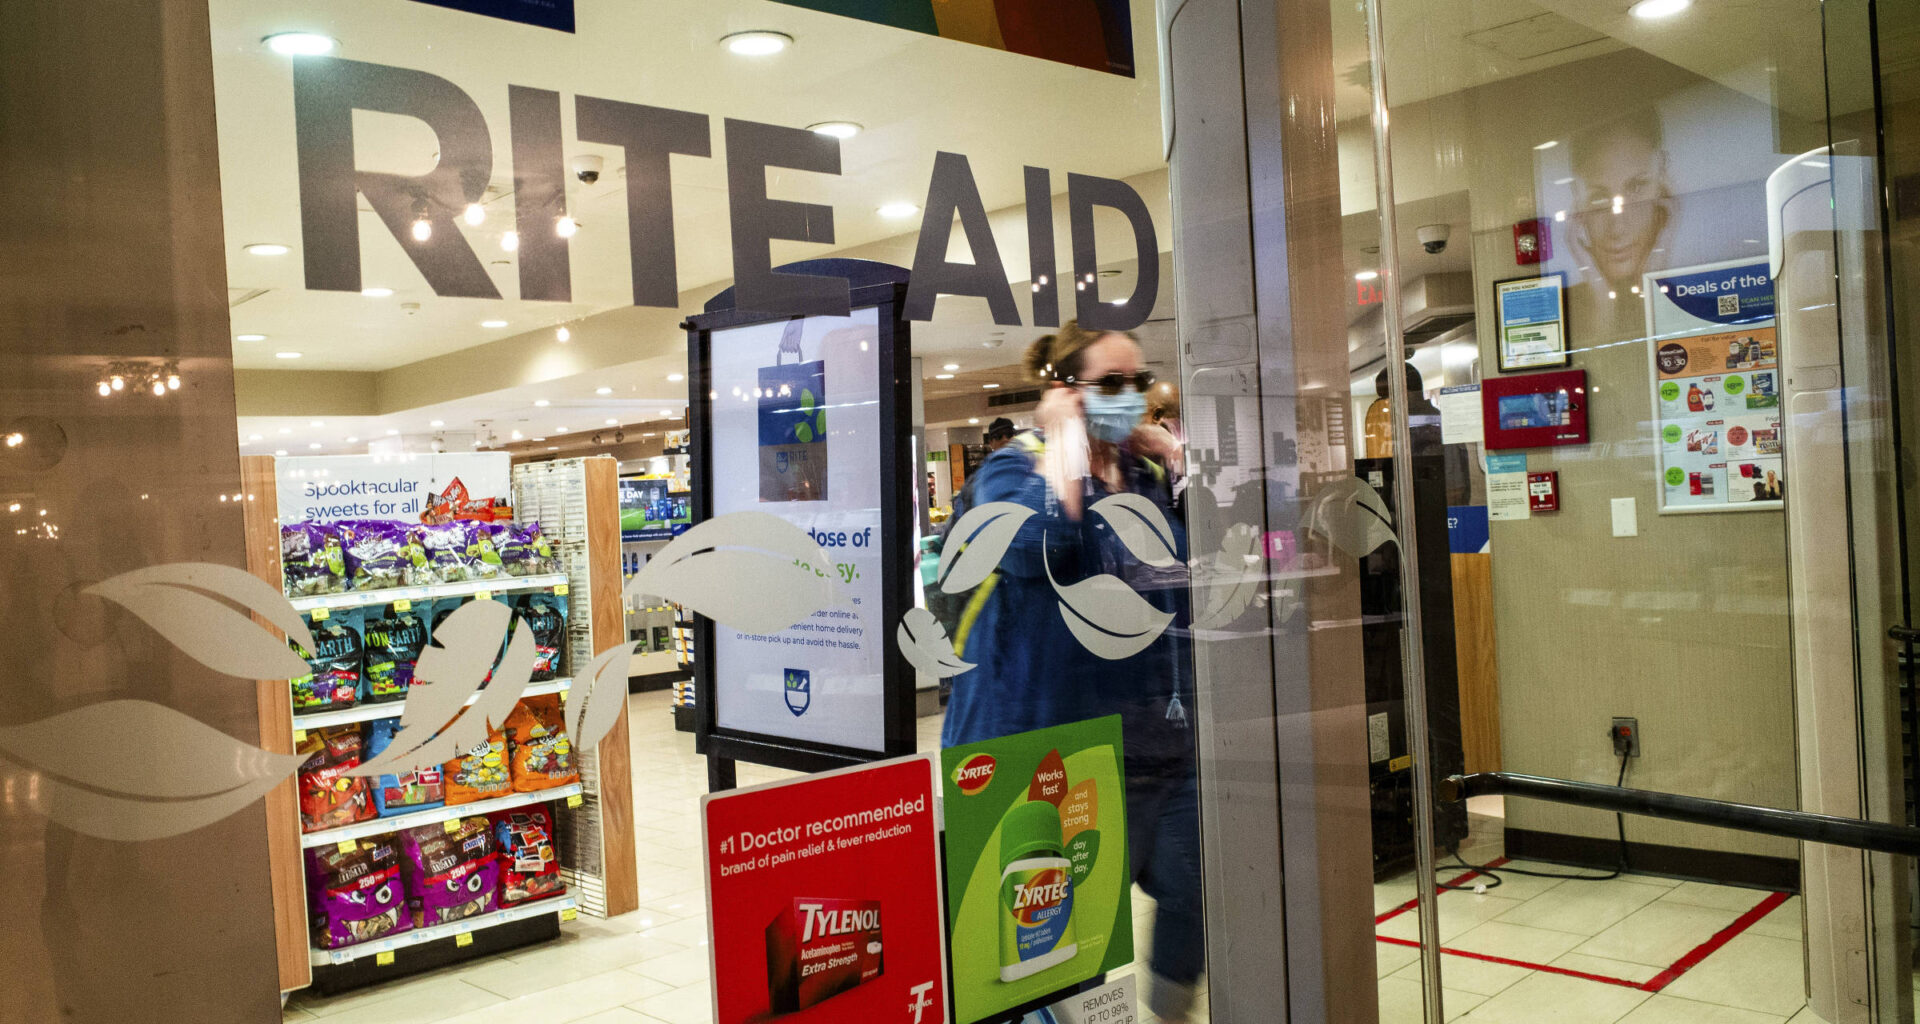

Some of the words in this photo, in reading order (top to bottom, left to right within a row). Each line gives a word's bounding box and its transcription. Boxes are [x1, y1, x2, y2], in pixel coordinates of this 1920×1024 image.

[293, 54, 851, 317] RITE
[901, 151, 1160, 331] AID
[1676, 280, 1718, 297] Deals
[1721, 276, 1738, 290] of
[1740, 274, 1767, 288] the
[304, 478, 419, 501] Spooktacular
[626, 490, 644, 499] DAY
[306, 503, 369, 519] sweets
[374, 500, 396, 515] for
[401, 498, 419, 513] all
[852, 527, 871, 547] of
[829, 609, 853, 620] online
[815, 624, 835, 634] home
[836, 625, 863, 637] delivery
[744, 632, 767, 642] in-store
[768, 634, 781, 644] pick
[782, 636, 791, 645] up
[792, 636, 805, 646] and
[806, 637, 824, 648] avoid
[825, 639, 837, 648] the
[838, 640, 861, 650] hassle.
[957, 764, 993, 782] ZYRTEC
[1037, 769, 1064, 784] Works
[1074, 790, 1088, 800] and
[1067, 802, 1089, 815] stays
[720, 834, 735, 854] #1
[740, 825, 802, 852] Doctor
[806, 793, 925, 837] recommended
[1063, 814, 1089, 828] strong
[720, 857, 756, 877] brand
[757, 854, 770, 868] of
[771, 849, 796, 868] pain
[798, 840, 825, 859] relief
[826, 840, 836, 852] &
[836, 834, 863, 850] fever
[865, 823, 912, 843] reduction
[1073, 840, 1087, 851] day
[1072, 850, 1089, 863] after
[1073, 863, 1089, 875] day.
[359, 875, 376, 889] 250
[1013, 880, 1069, 911] ZYRTEC
[1036, 906, 1063, 921] ALLERGY
[799, 903, 880, 943] TYLENOL
[801, 943, 841, 961] Acetaminophen
[802, 961, 827, 977] Extra
[828, 952, 858, 969] Strength
[1083, 987, 1125, 1012] REMOVES
[1098, 1010, 1111, 1022] TO
[1111, 1001, 1129, 1017] 99%
